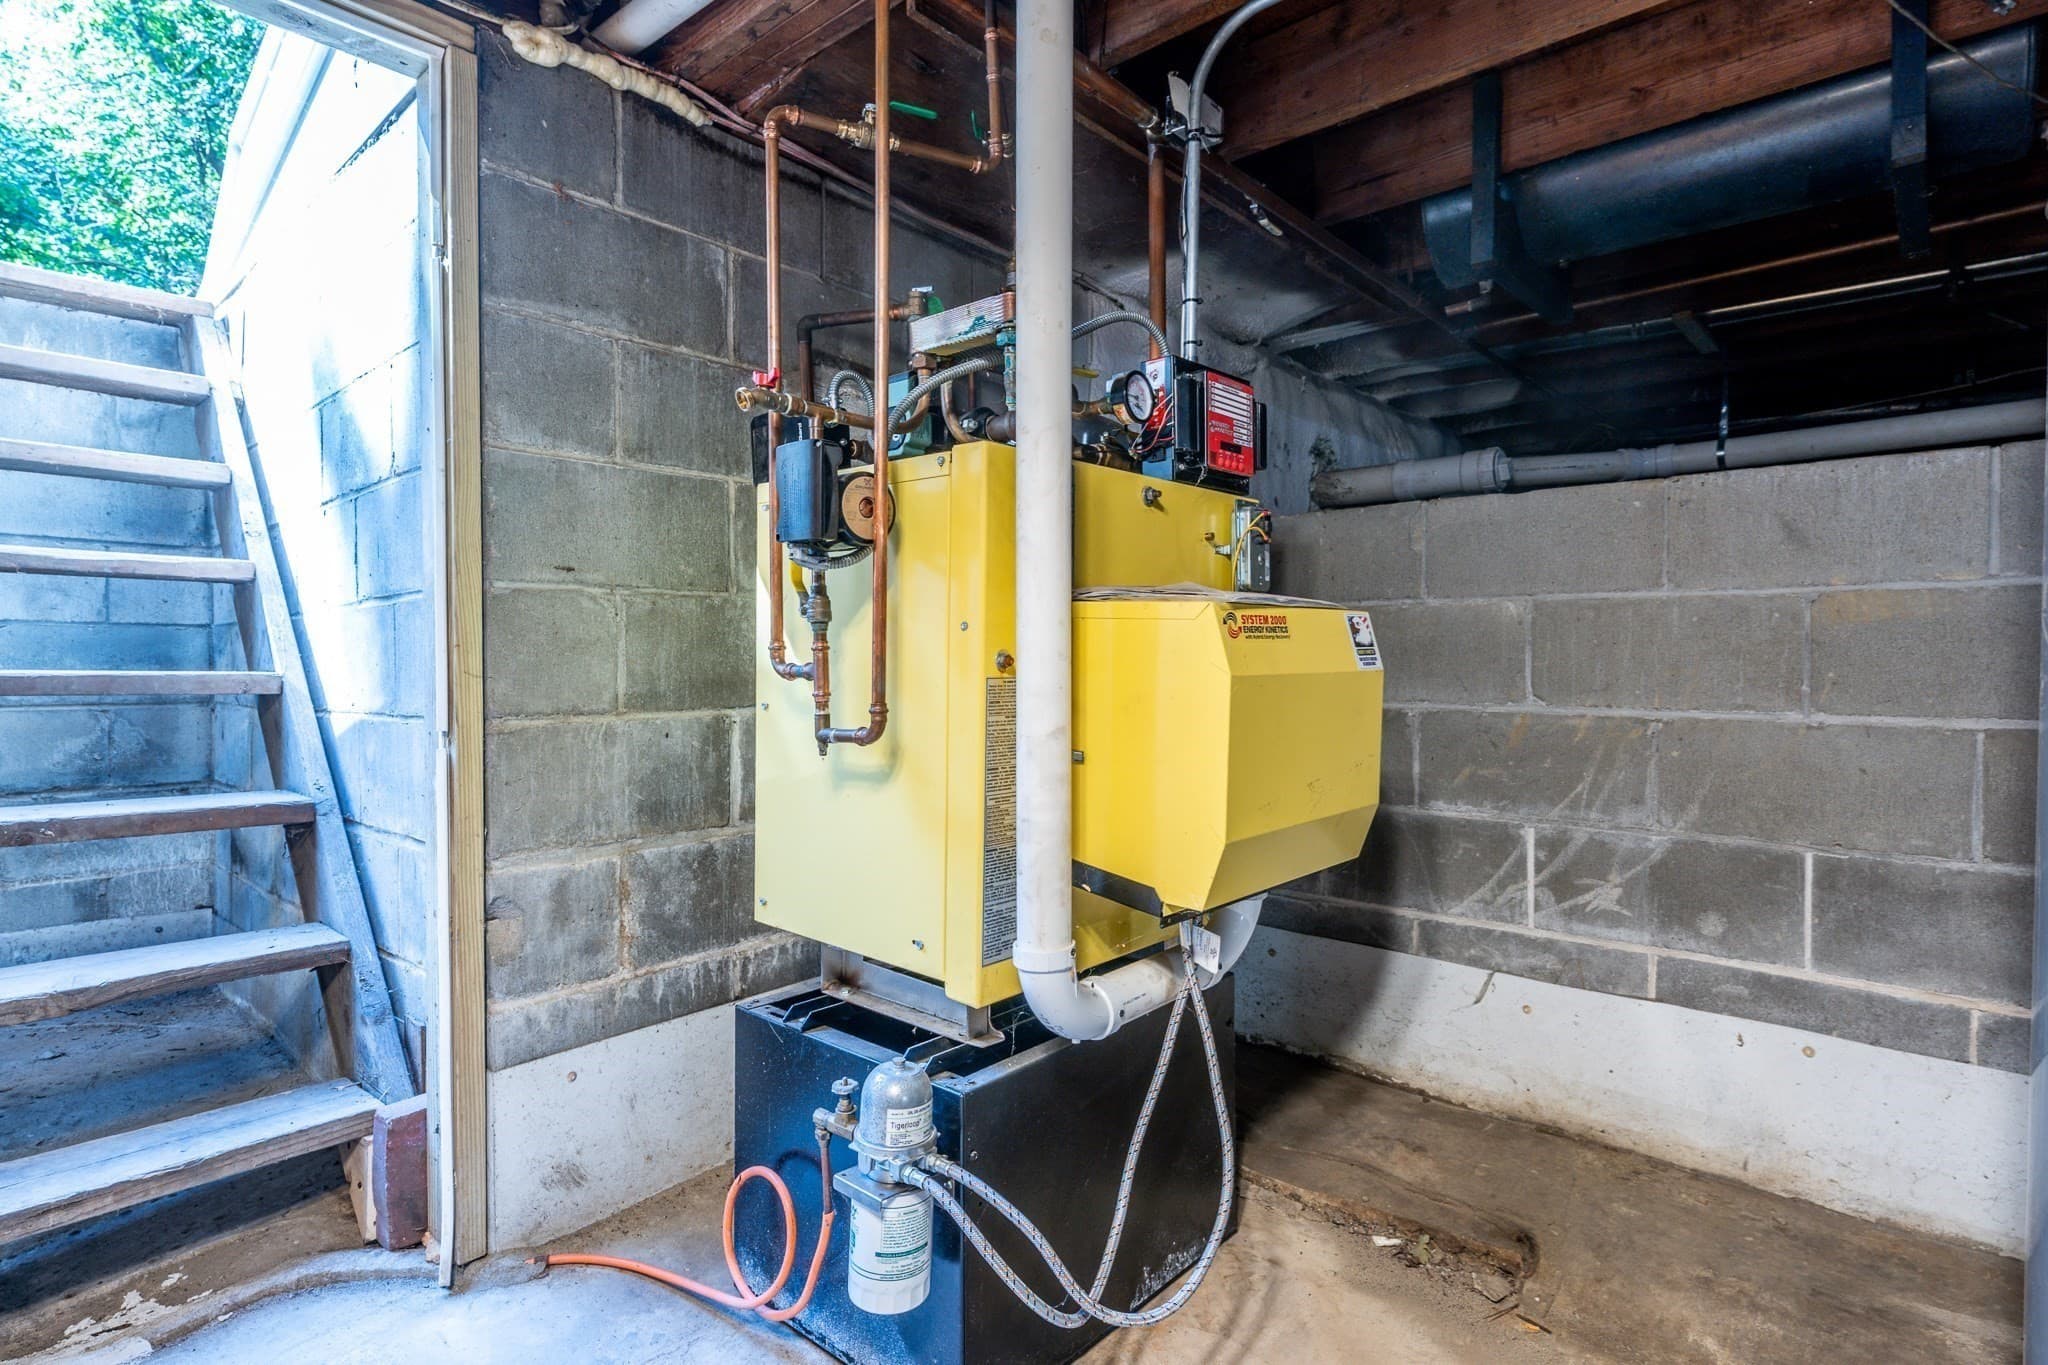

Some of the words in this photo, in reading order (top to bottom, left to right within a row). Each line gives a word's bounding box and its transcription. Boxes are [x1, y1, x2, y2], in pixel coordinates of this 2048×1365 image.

[1241, 614, 1269, 625] SYSTEM
[1270, 615, 1286, 625] 2000
[1243, 626, 1264, 634] ENERGY
[1265, 626, 1288, 634] KINETICS
